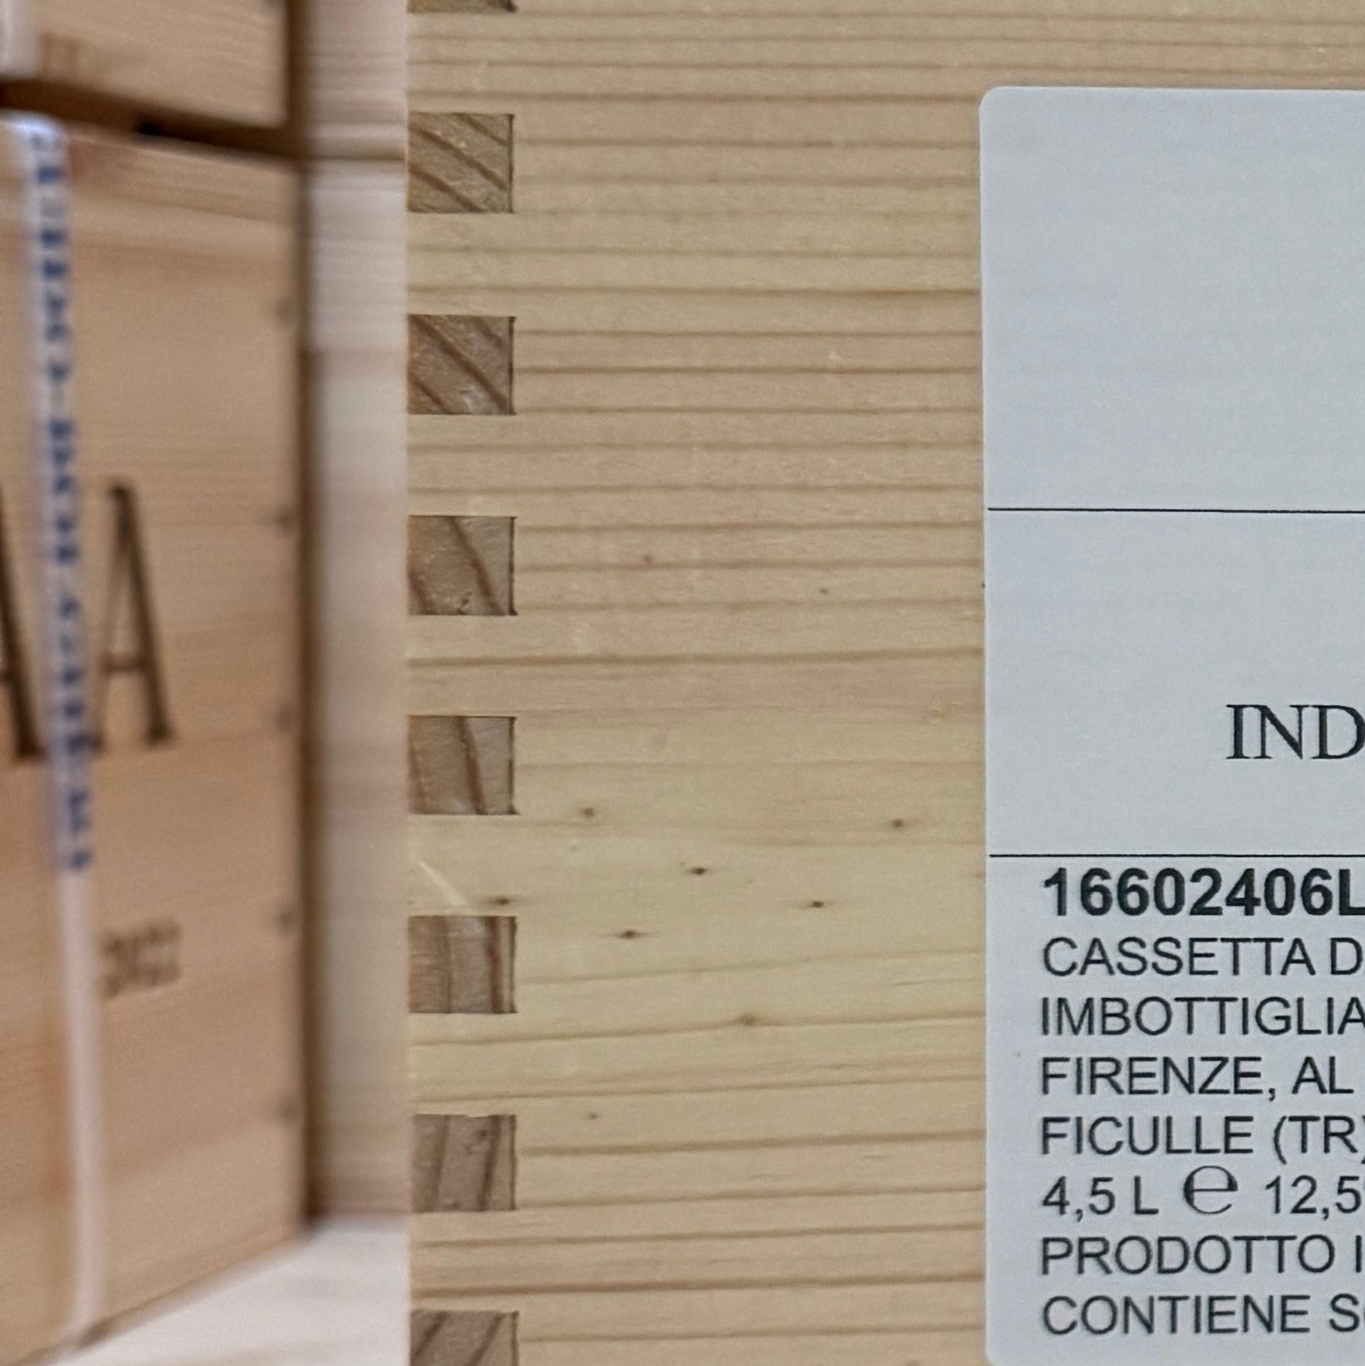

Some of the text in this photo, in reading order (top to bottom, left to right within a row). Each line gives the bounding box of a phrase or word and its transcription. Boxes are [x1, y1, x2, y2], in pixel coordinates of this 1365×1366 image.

[1042, 936, 1317, 977] CASSETTA
[1041, 1055, 1277, 1102] FIRENZE,
[1291, 1055, 1355, 1095] AL
[1041, 1115, 1254, 1156] FICULLE
[1041, 1175, 1116, 1223] 4,5
[1133, 1175, 1160, 1216] L
[1041, 1233, 1336, 1276] PRODOTTO
[1041, 1294, 1311, 1336] CONTIENE
